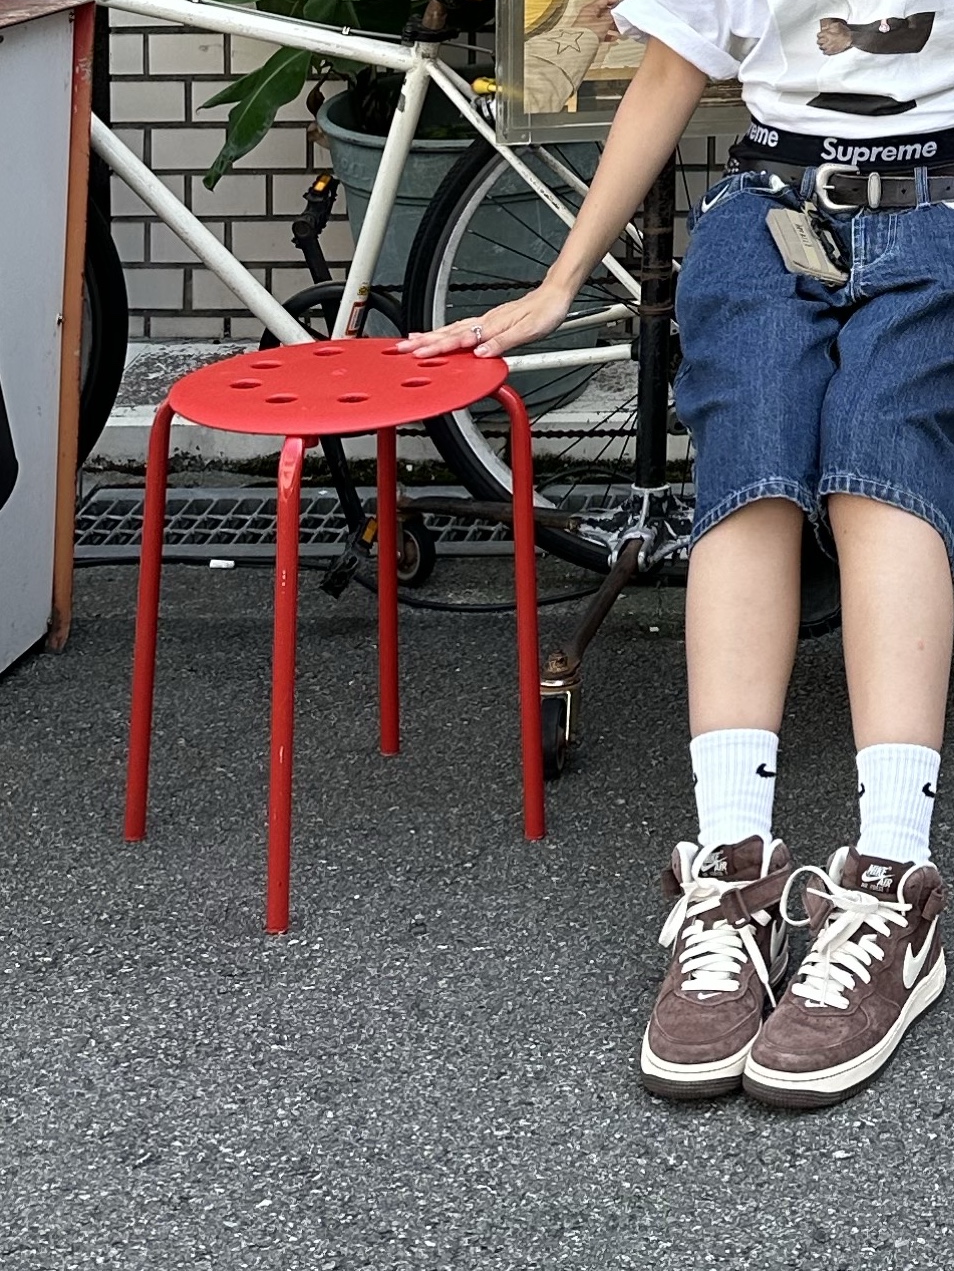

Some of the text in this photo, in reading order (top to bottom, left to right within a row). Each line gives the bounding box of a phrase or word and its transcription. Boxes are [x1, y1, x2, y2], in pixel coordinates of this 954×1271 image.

[747, 122, 779, 148] eme
[820, 136, 938, 166] Supreme
[876, 878, 893, 888] AIR
